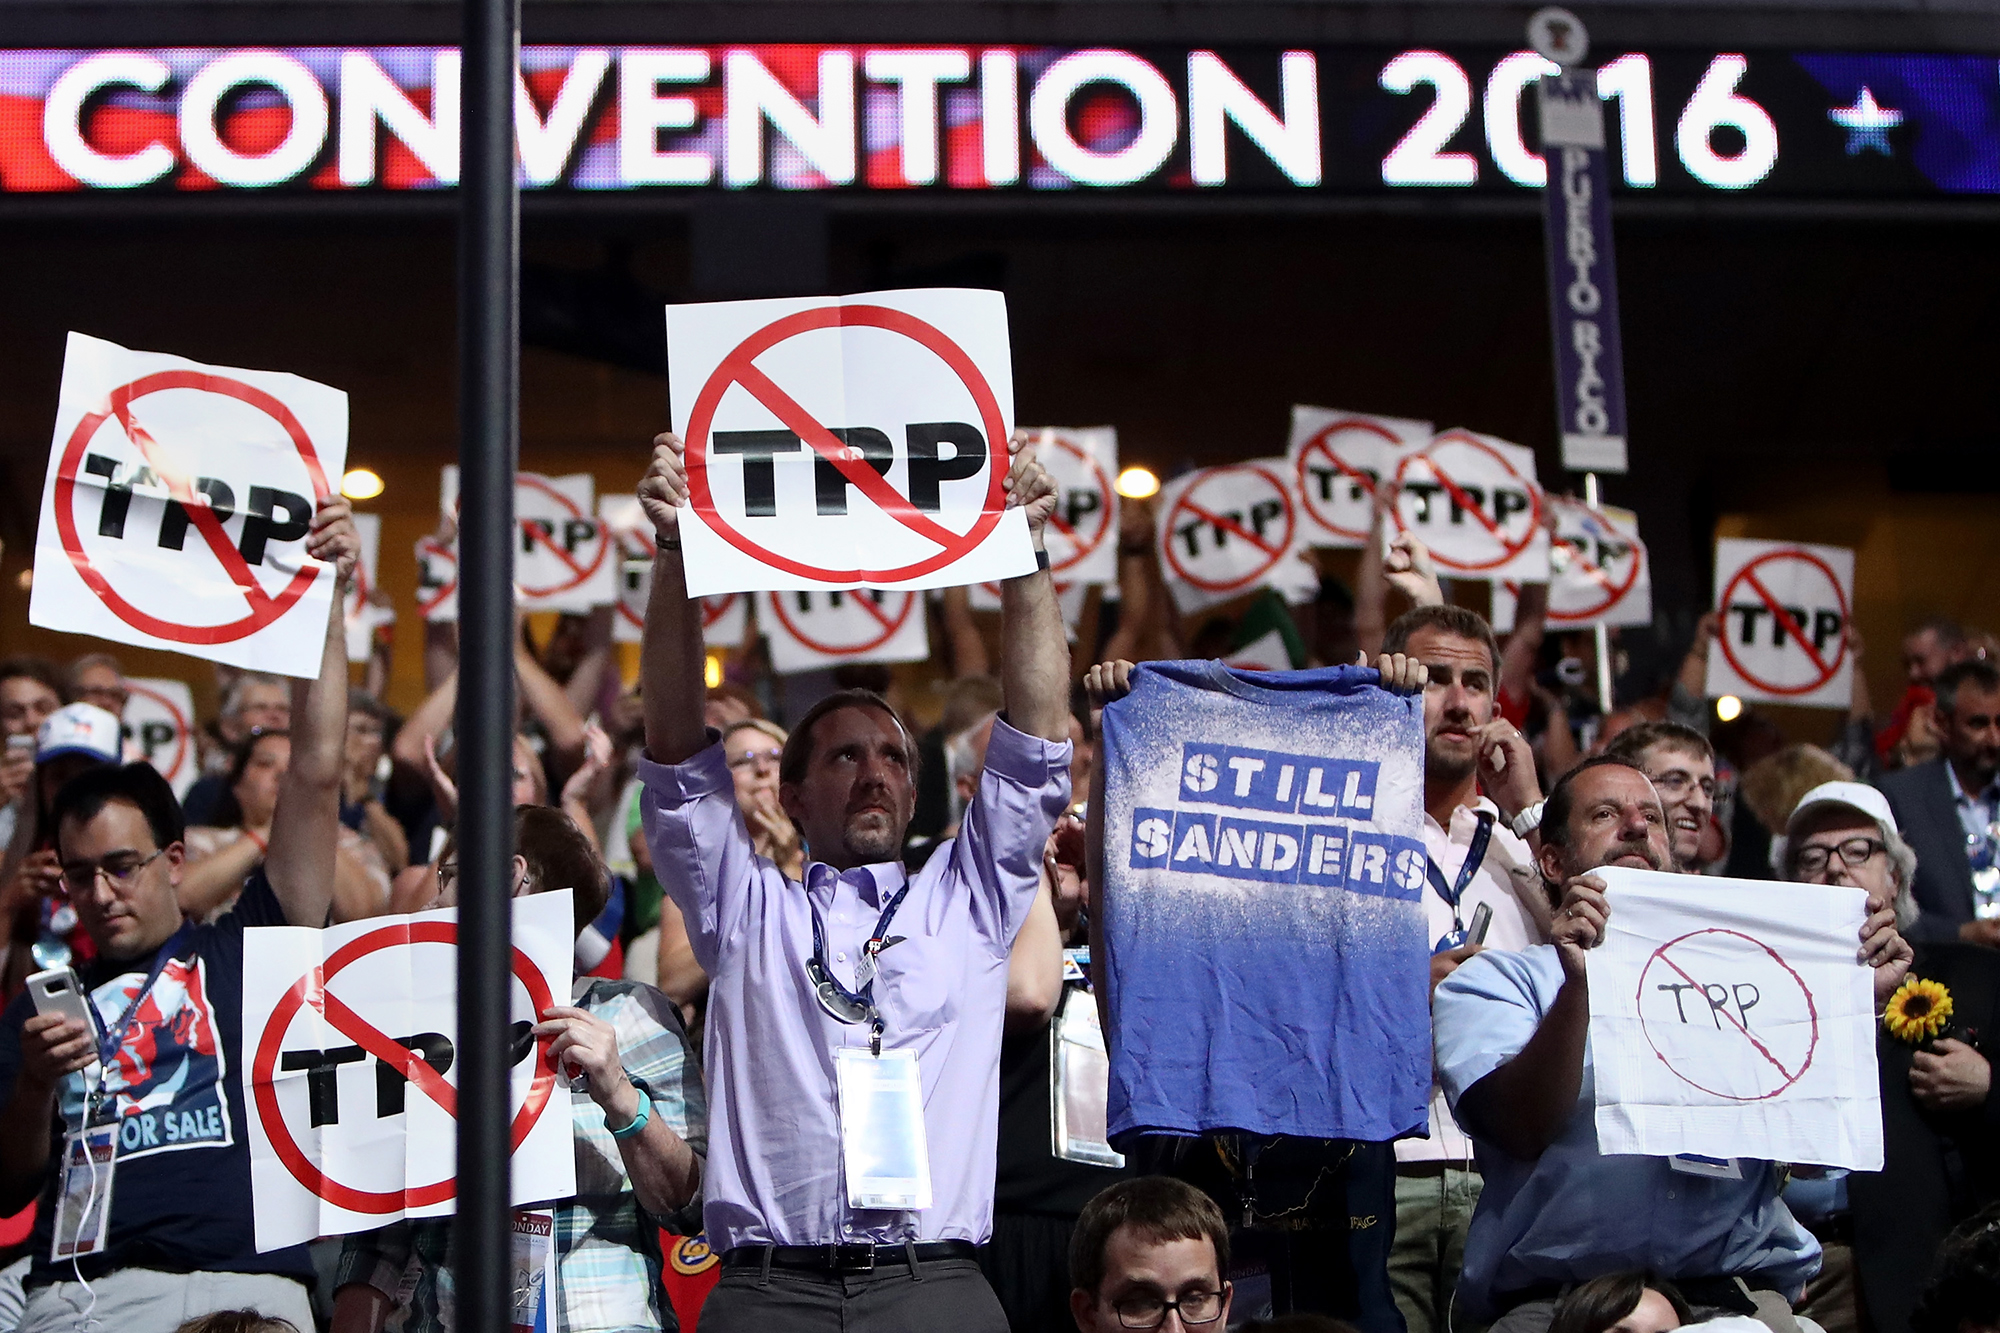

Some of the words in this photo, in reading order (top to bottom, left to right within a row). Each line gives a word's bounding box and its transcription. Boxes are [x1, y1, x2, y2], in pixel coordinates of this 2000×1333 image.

[44, 50, 1321, 188] CONVENTION
[1561, 148, 1601, 313] PUERTO
[1572, 319, 1610, 434] RICO
[521, 517, 597, 554] PP
[1730, 603, 1842, 650] TPP
[1184, 753, 1372, 810] STILL
[1135, 818, 1427, 890] SANDERS
[121, 1112, 159, 1150] OR
[164, 1105, 223, 1141] SALE
[512, 1221, 549, 1235] ONDAY
